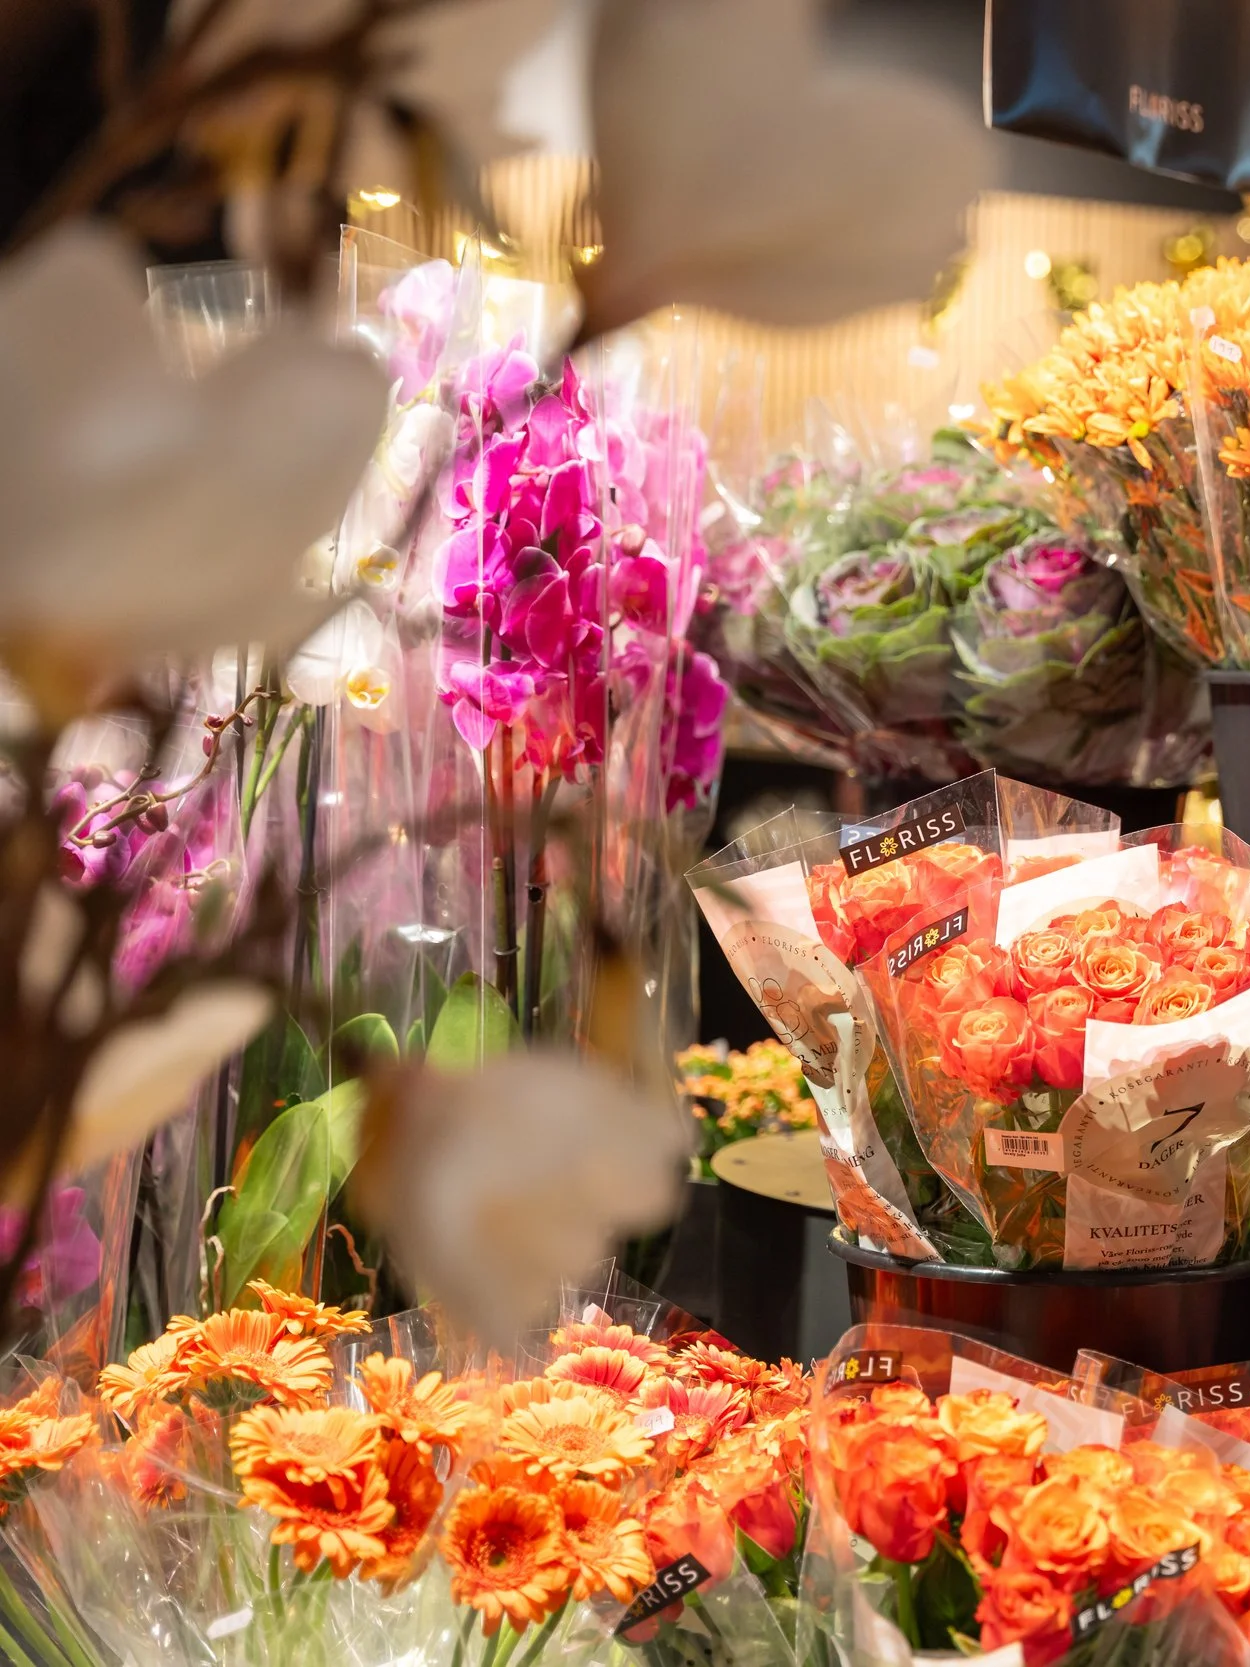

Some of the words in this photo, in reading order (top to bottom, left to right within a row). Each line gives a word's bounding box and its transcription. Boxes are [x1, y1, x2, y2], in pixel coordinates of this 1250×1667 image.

[849, 812, 956, 869] FLORISS
[761, 936, 807, 958] FLORISS
[1108, 1058, 1210, 1100] ROSEGARANTI
[1150, 1101, 1206, 1154] 7
[1138, 1139, 1185, 1170] DAGER
[1121, 1382, 1243, 1421] FLORISS
